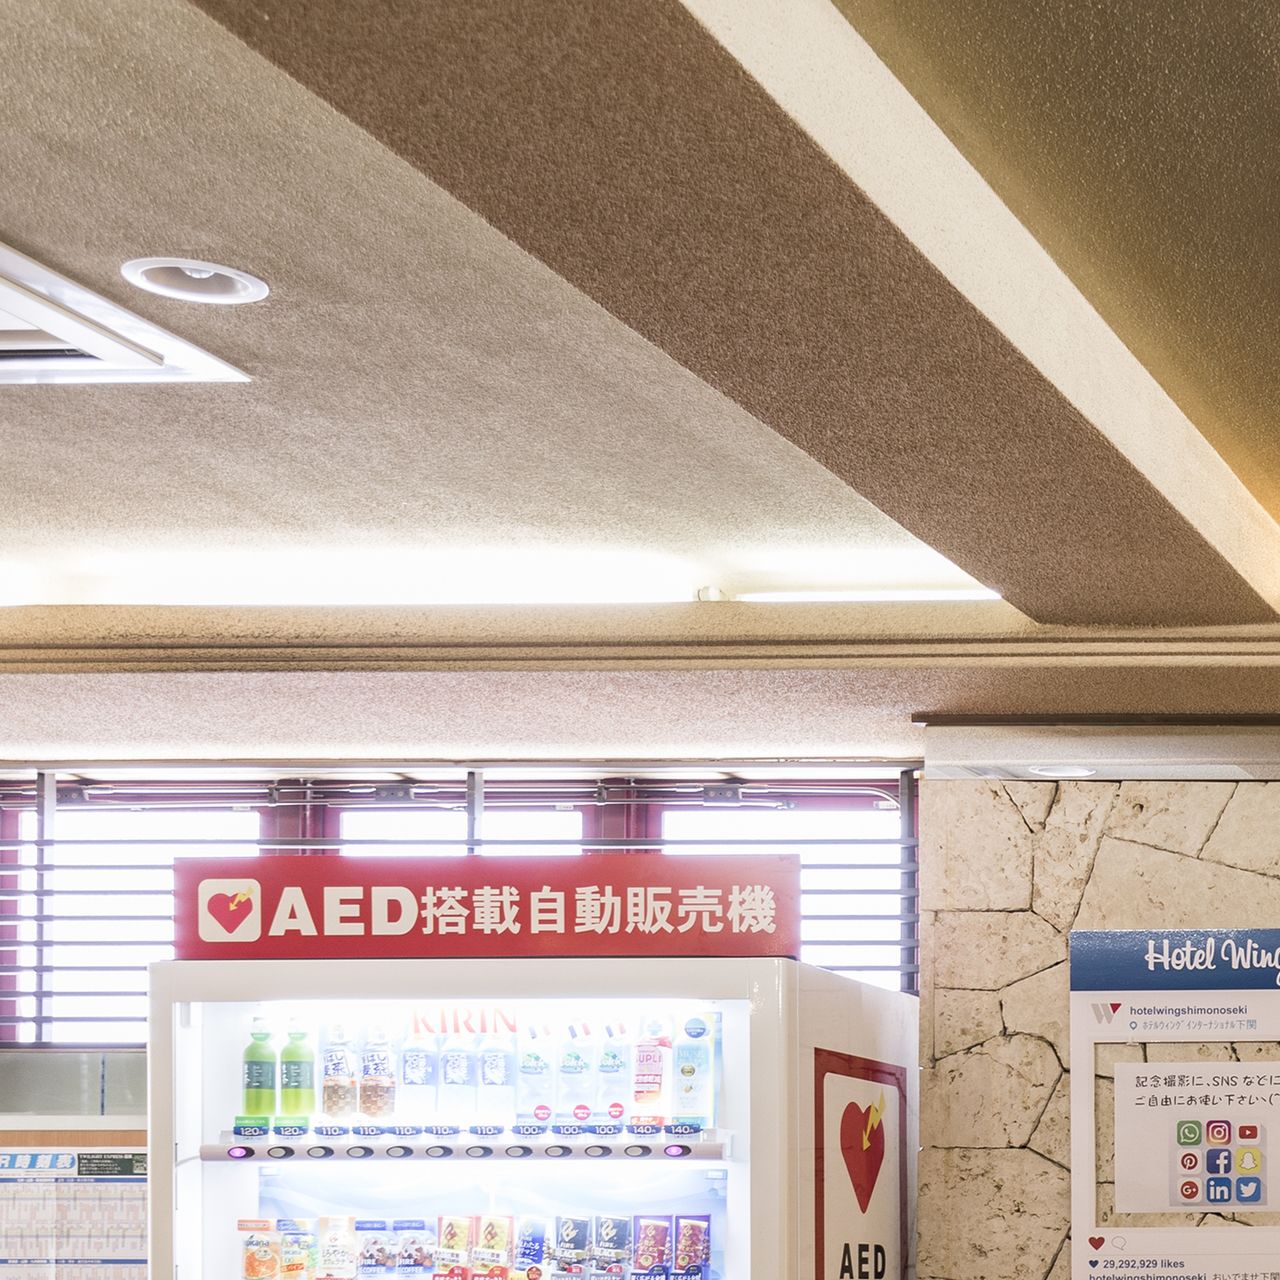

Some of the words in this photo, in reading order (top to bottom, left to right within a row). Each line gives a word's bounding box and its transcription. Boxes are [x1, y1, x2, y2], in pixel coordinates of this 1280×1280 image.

[268, 886, 778, 937] AED搭載自動販売機
[1144, 937, 1217, 970] Hotel
[412, 1007, 517, 1034] KIRIN
[1130, 1005, 1248, 1017] hotelwingshimonoseki
[839, 1243, 886, 1280] AED
[1103, 1259, 1158, 1270] 29,292,929
[1160, 1259, 1185, 1269] likes
